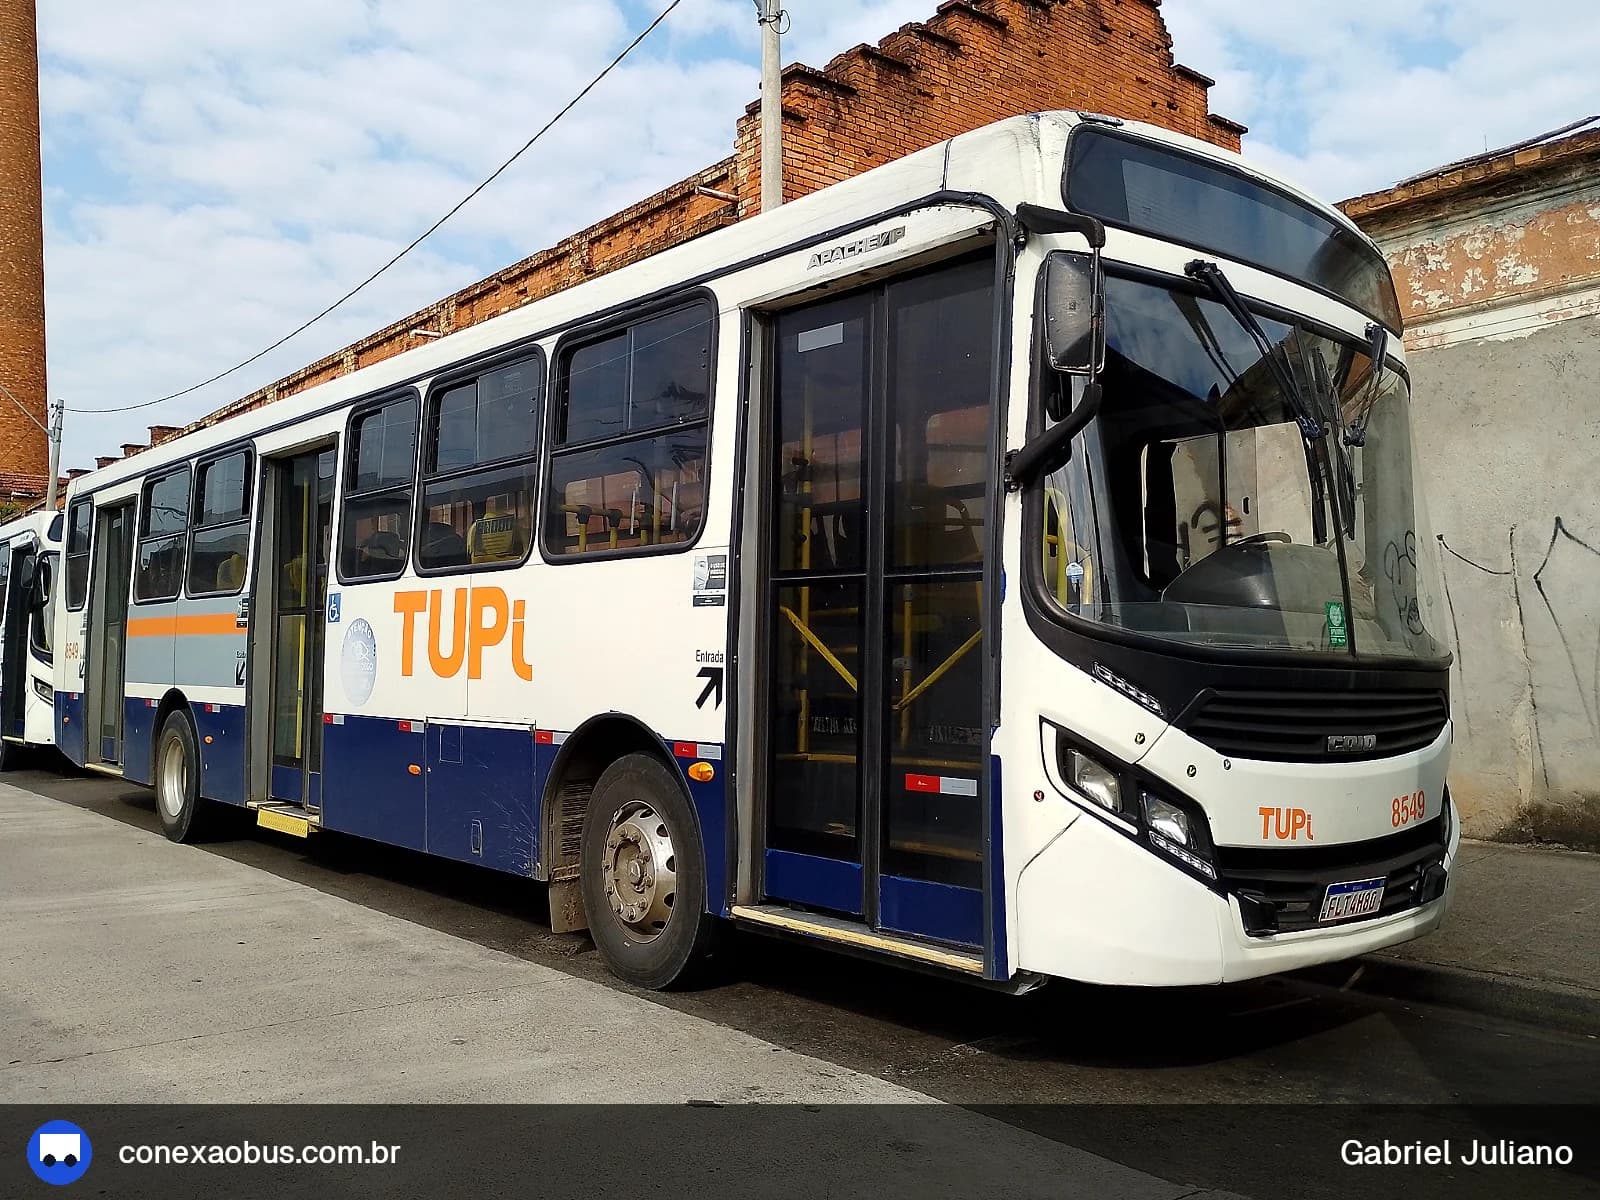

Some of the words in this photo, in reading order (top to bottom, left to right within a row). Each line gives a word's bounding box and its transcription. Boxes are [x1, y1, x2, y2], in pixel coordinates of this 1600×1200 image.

[806, 236, 880, 271] APACHE
[695, 649, 724, 663] Entrada
[1327, 734, 1377, 752] CAIO
[1391, 790, 1425, 827] 8549
